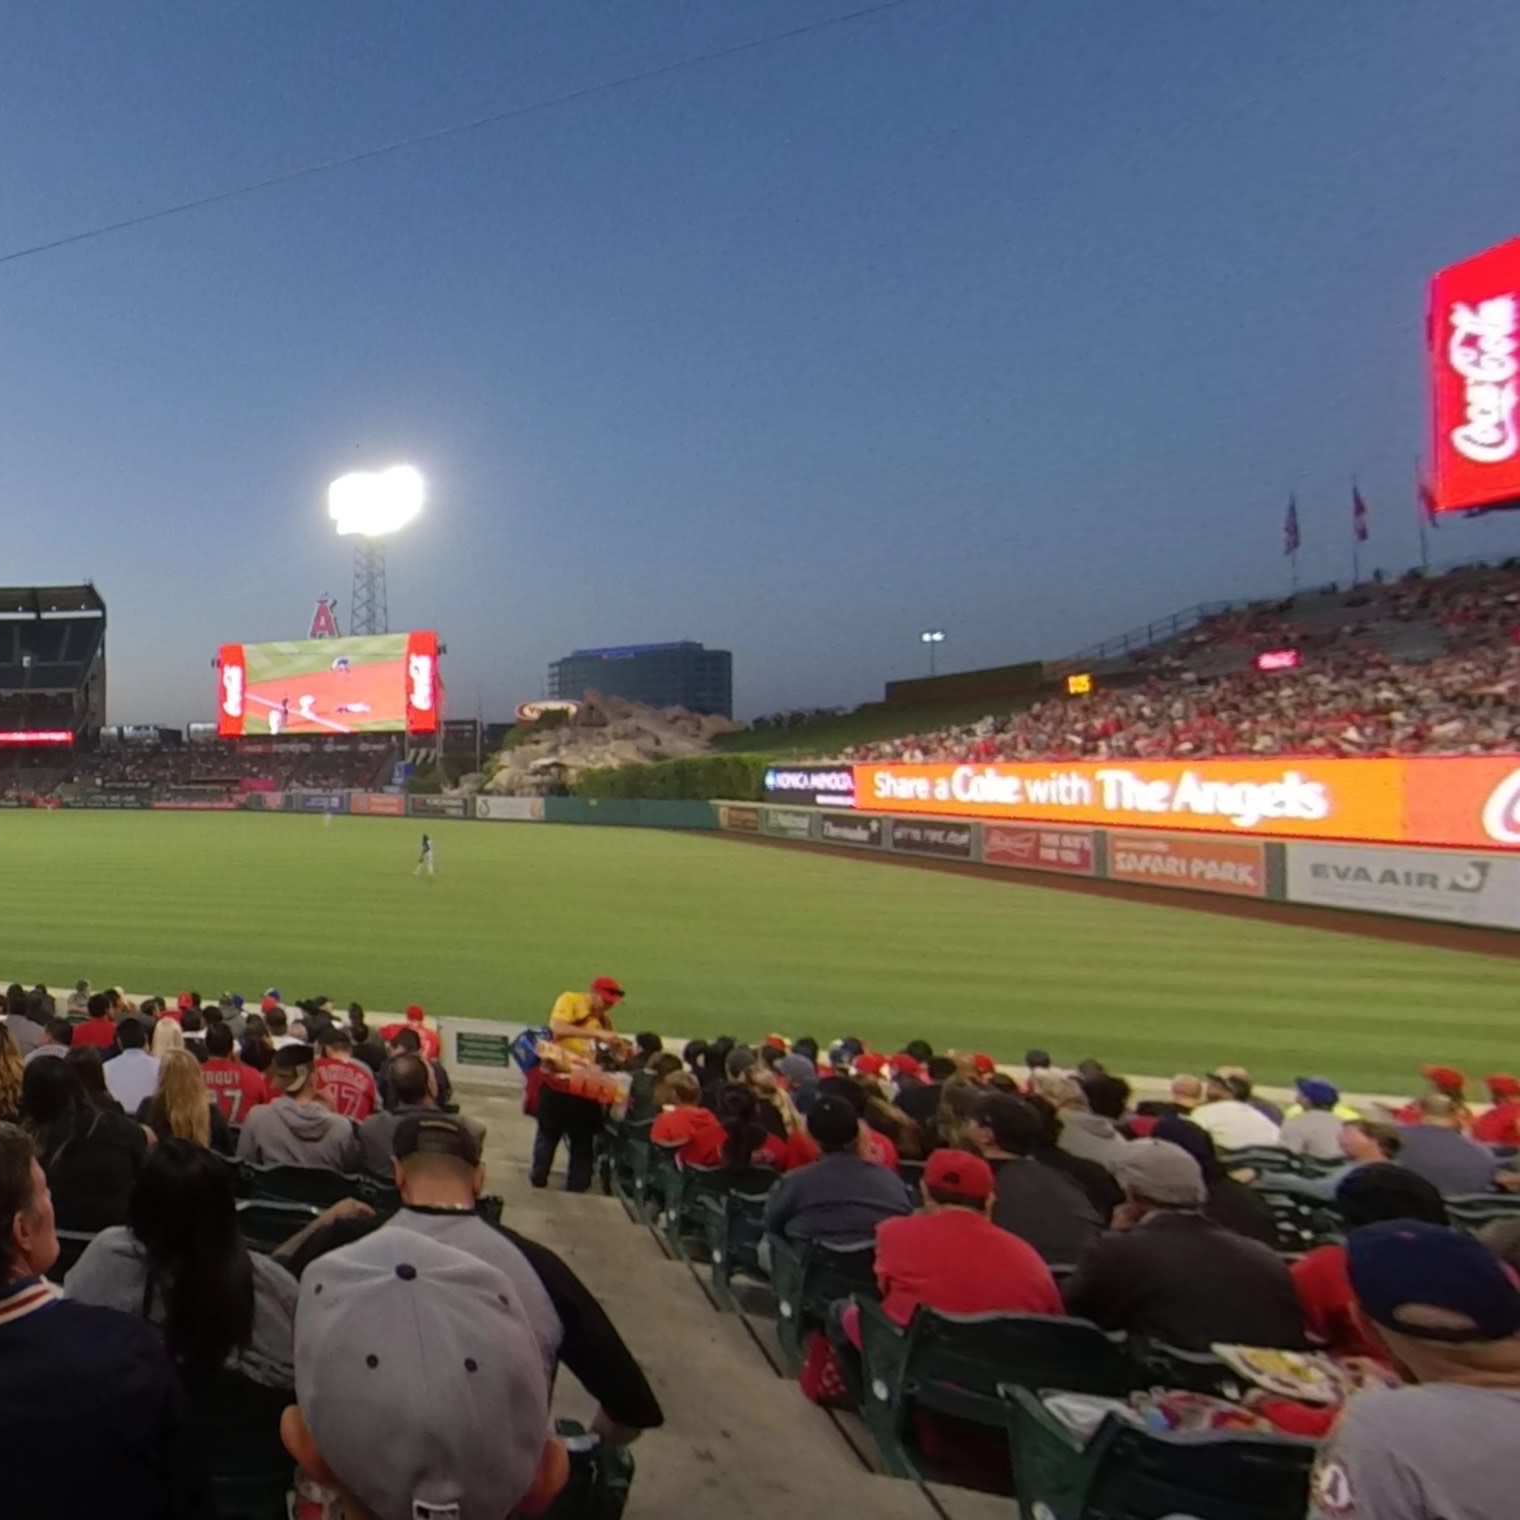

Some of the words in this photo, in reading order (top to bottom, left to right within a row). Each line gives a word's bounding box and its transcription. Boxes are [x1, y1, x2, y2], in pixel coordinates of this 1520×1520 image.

[1448, 290, 1519, 463] Coca-Cola
[873, 771, 929, 800] Share
[934, 777, 950, 800] a
[952, 764, 1021, 804] Coke
[1025, 771, 1092, 805] with
[1096, 769, 1171, 812] The
[1172, 770, 1330, 828] Angels
[1114, 851, 1187, 877] SAFARI
[1190, 857, 1259, 887] PARK
[1310, 863, 1373, 884] EVA
[1378, 868, 1440, 889] AIR
